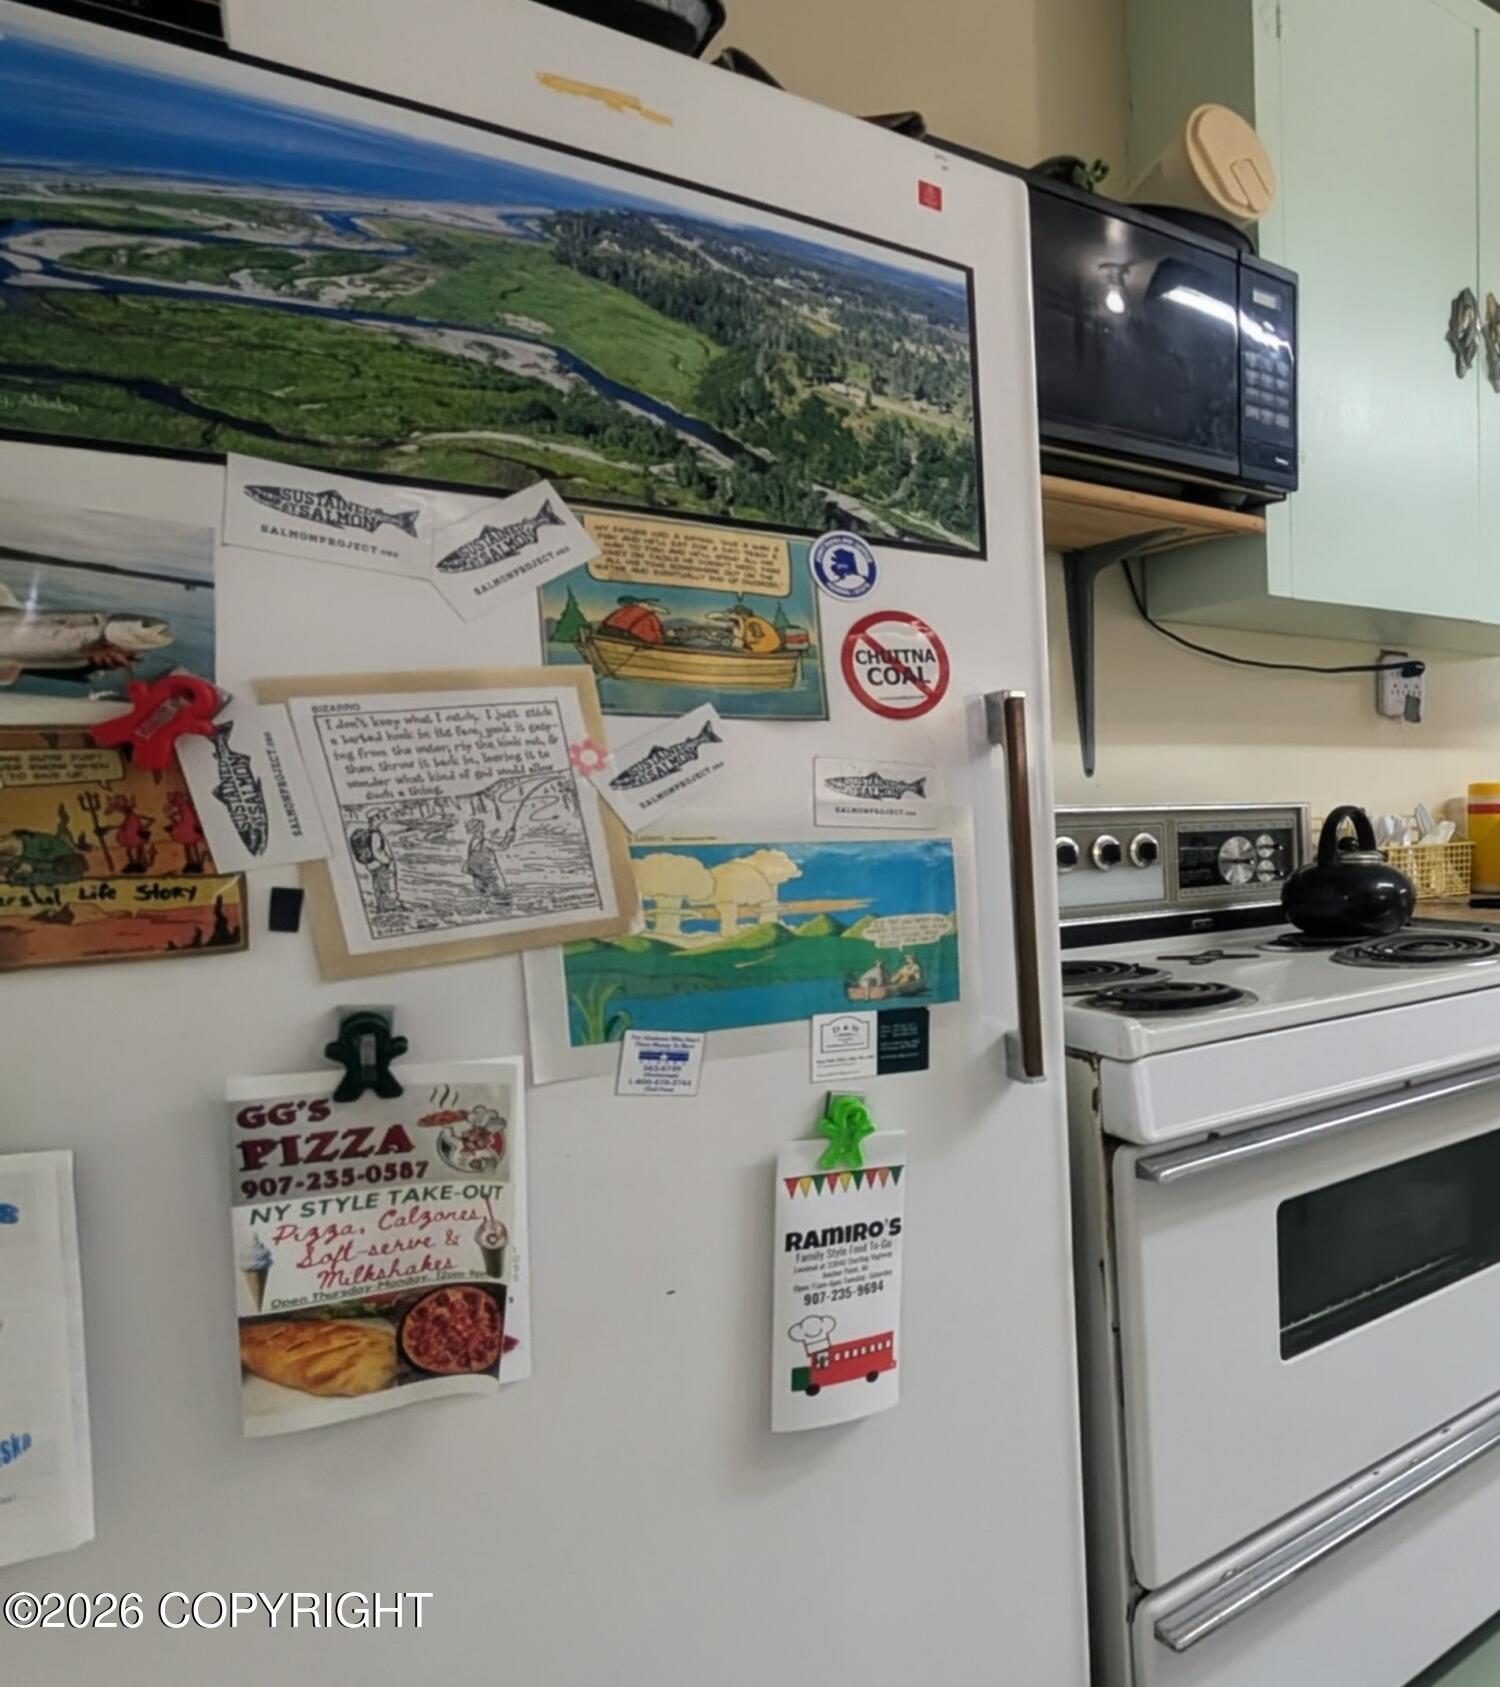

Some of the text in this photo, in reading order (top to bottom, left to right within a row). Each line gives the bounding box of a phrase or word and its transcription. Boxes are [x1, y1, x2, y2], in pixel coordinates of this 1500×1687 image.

[279, 487, 375, 516] SUSTAINED
[281, 502, 378, 531] BY SALMON
[457, 524, 526, 560] SUSTAINED
[478, 528, 537, 566] SALMON
[855, 649, 937, 666] CHUITNA
[866, 666, 931, 687] COAL
[218, 757, 253, 833] SUSTAINED
[231, 755, 264, 815] SALMON
[79, 883, 118, 901] Life
[134, 883, 198, 902] Story
[237, 1098, 332, 1130] GG'S
[237, 1123, 416, 1172] PIZZA
[240, 1160, 430, 1199] 907-235-0587
[249, 1184, 504, 1226] NY STYLE TAKE-OUT
[271, 1222, 366, 1248] Pizza,
[444, 1230, 461, 1247] &
[785, 1217, 902, 1253] RAMIRO'S
[316, 1254, 458, 1291] Milkshakes
[803, 1279, 885, 1307] 907-235-9694
